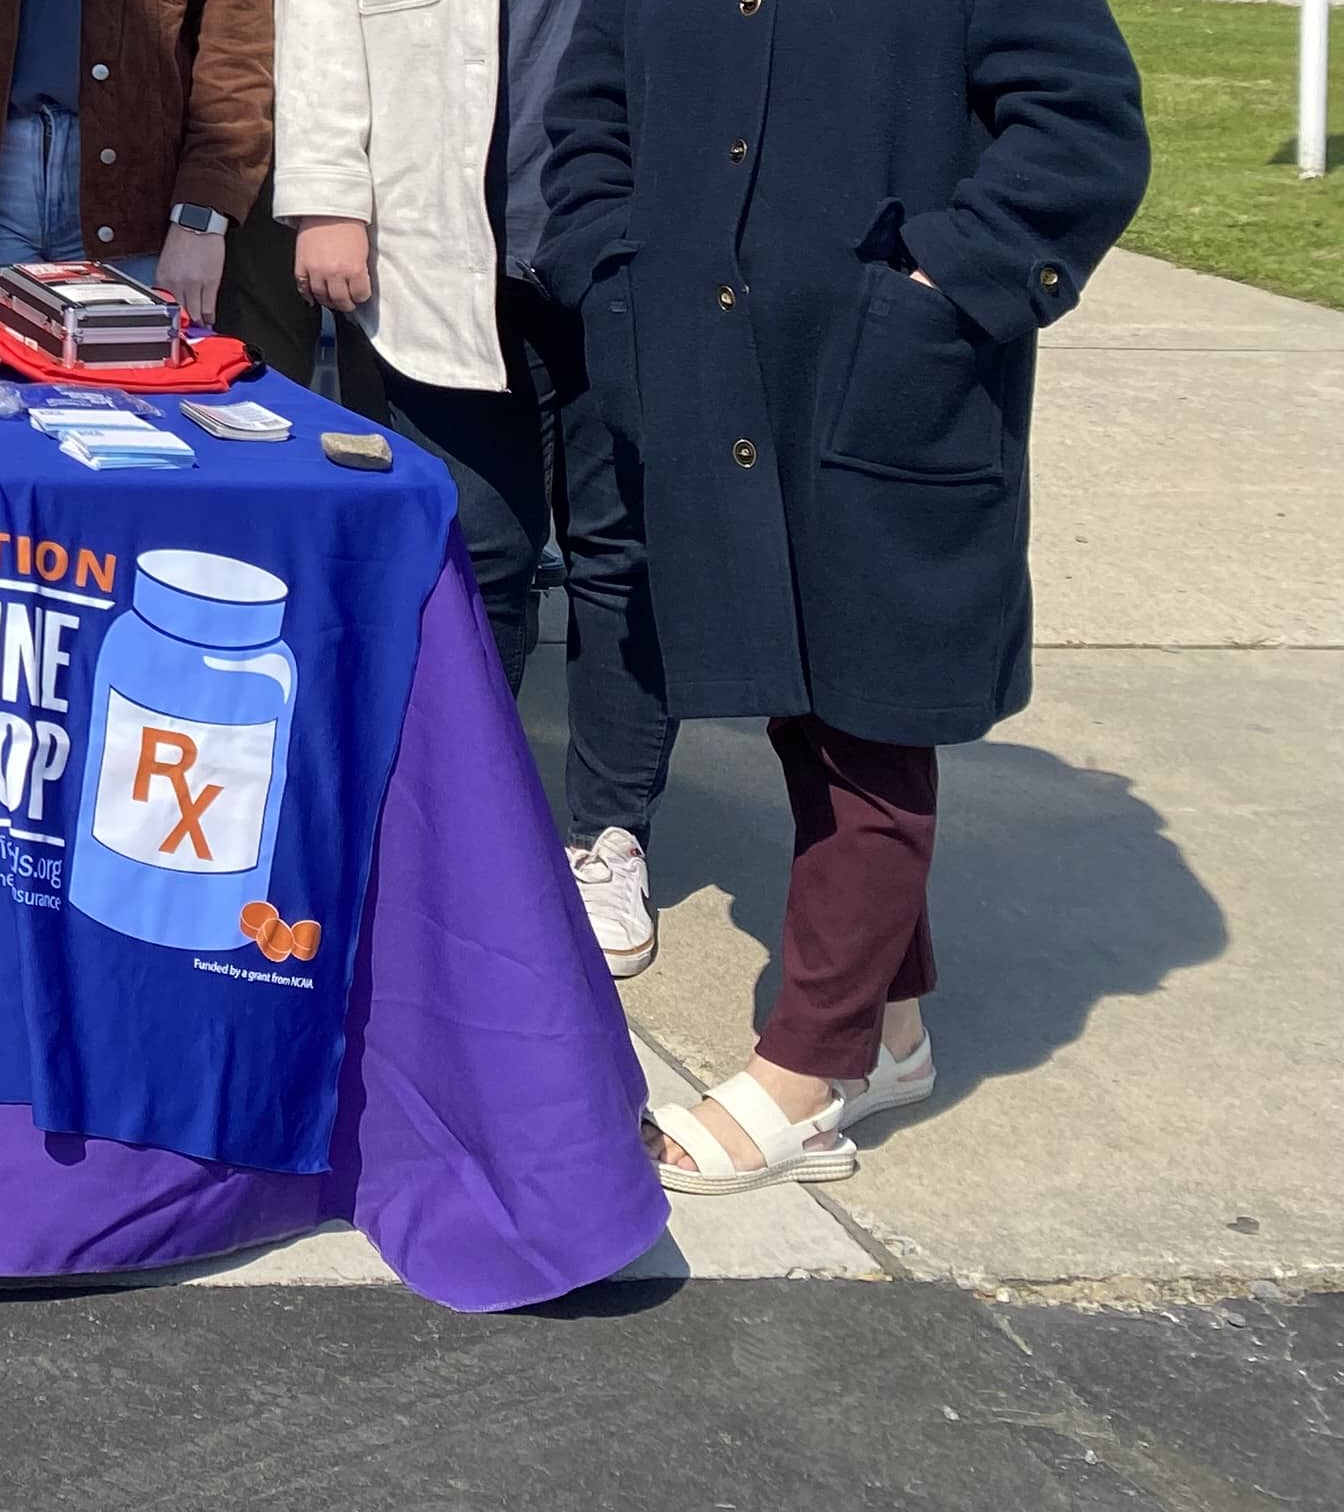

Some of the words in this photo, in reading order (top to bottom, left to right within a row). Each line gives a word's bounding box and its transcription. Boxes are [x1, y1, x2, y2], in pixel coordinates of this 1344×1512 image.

[12, 886, 62, 912] nsurance
[193, 957, 229, 976] Funded
[229, 964, 242, 979] by
[241, 969, 248, 978] a
[248, 970, 271, 983] grant
[271, 972, 291, 986] from
